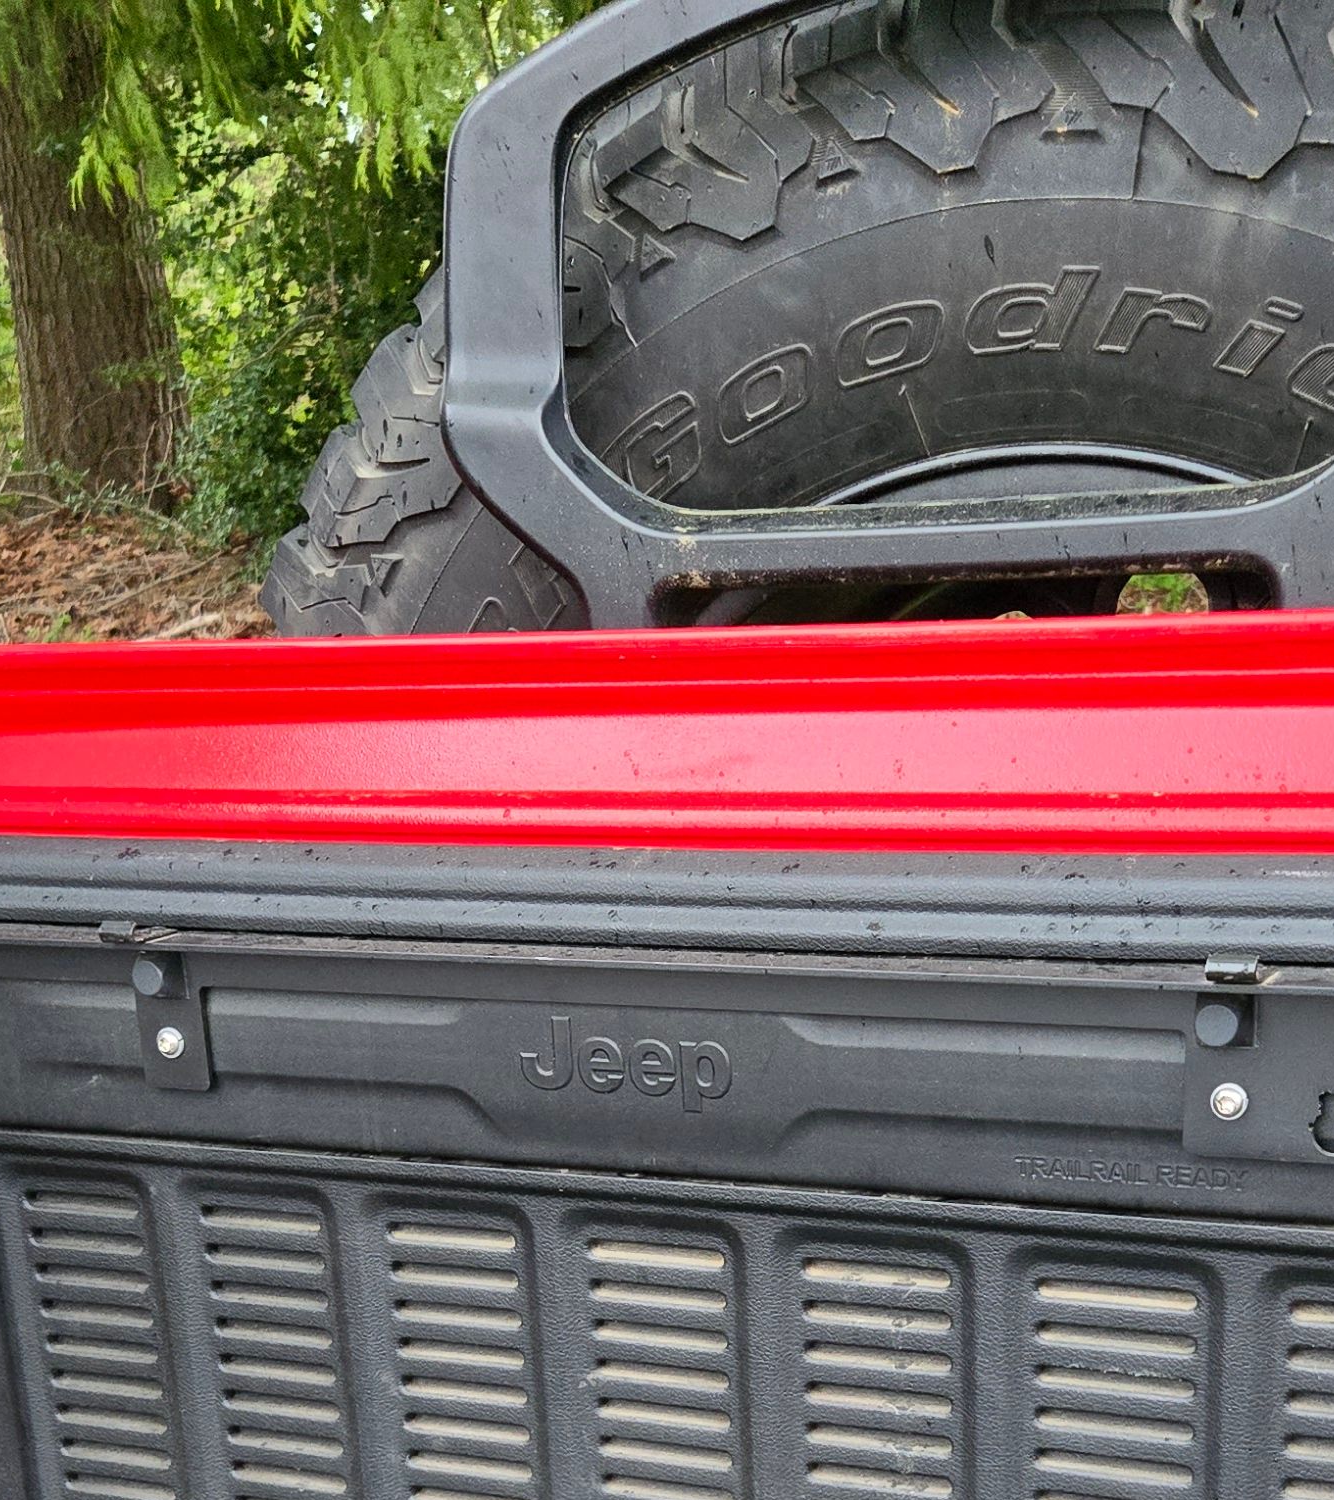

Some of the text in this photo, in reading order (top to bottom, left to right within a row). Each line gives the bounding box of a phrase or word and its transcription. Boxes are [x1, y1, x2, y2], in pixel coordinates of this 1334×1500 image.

[519, 1015, 733, 1114] Jeep
[1015, 1155, 1249, 1192] TRAILRAIL READY
